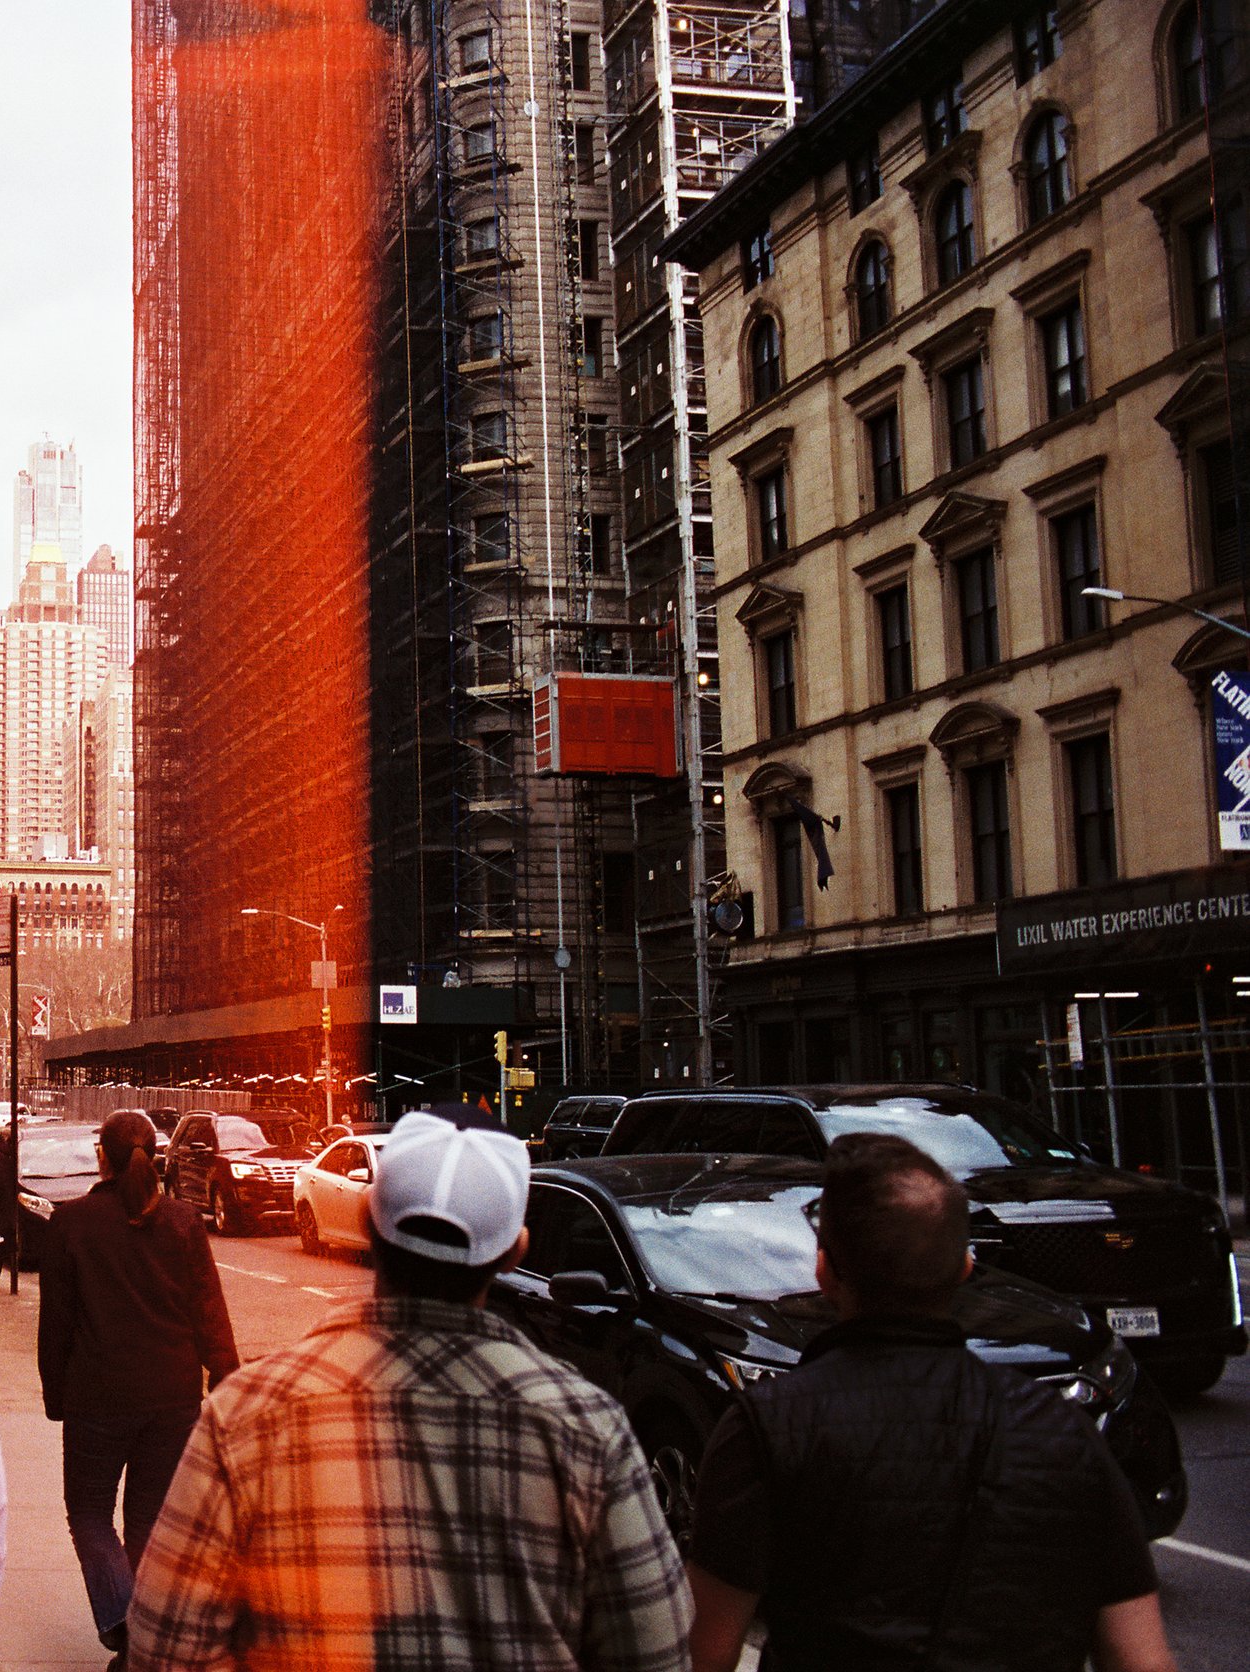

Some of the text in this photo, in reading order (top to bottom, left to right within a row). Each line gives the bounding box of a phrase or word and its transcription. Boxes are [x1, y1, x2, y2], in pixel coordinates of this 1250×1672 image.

[1017, 893, 1250, 947] LIXIL WATER EXPERIENCE CENTE
